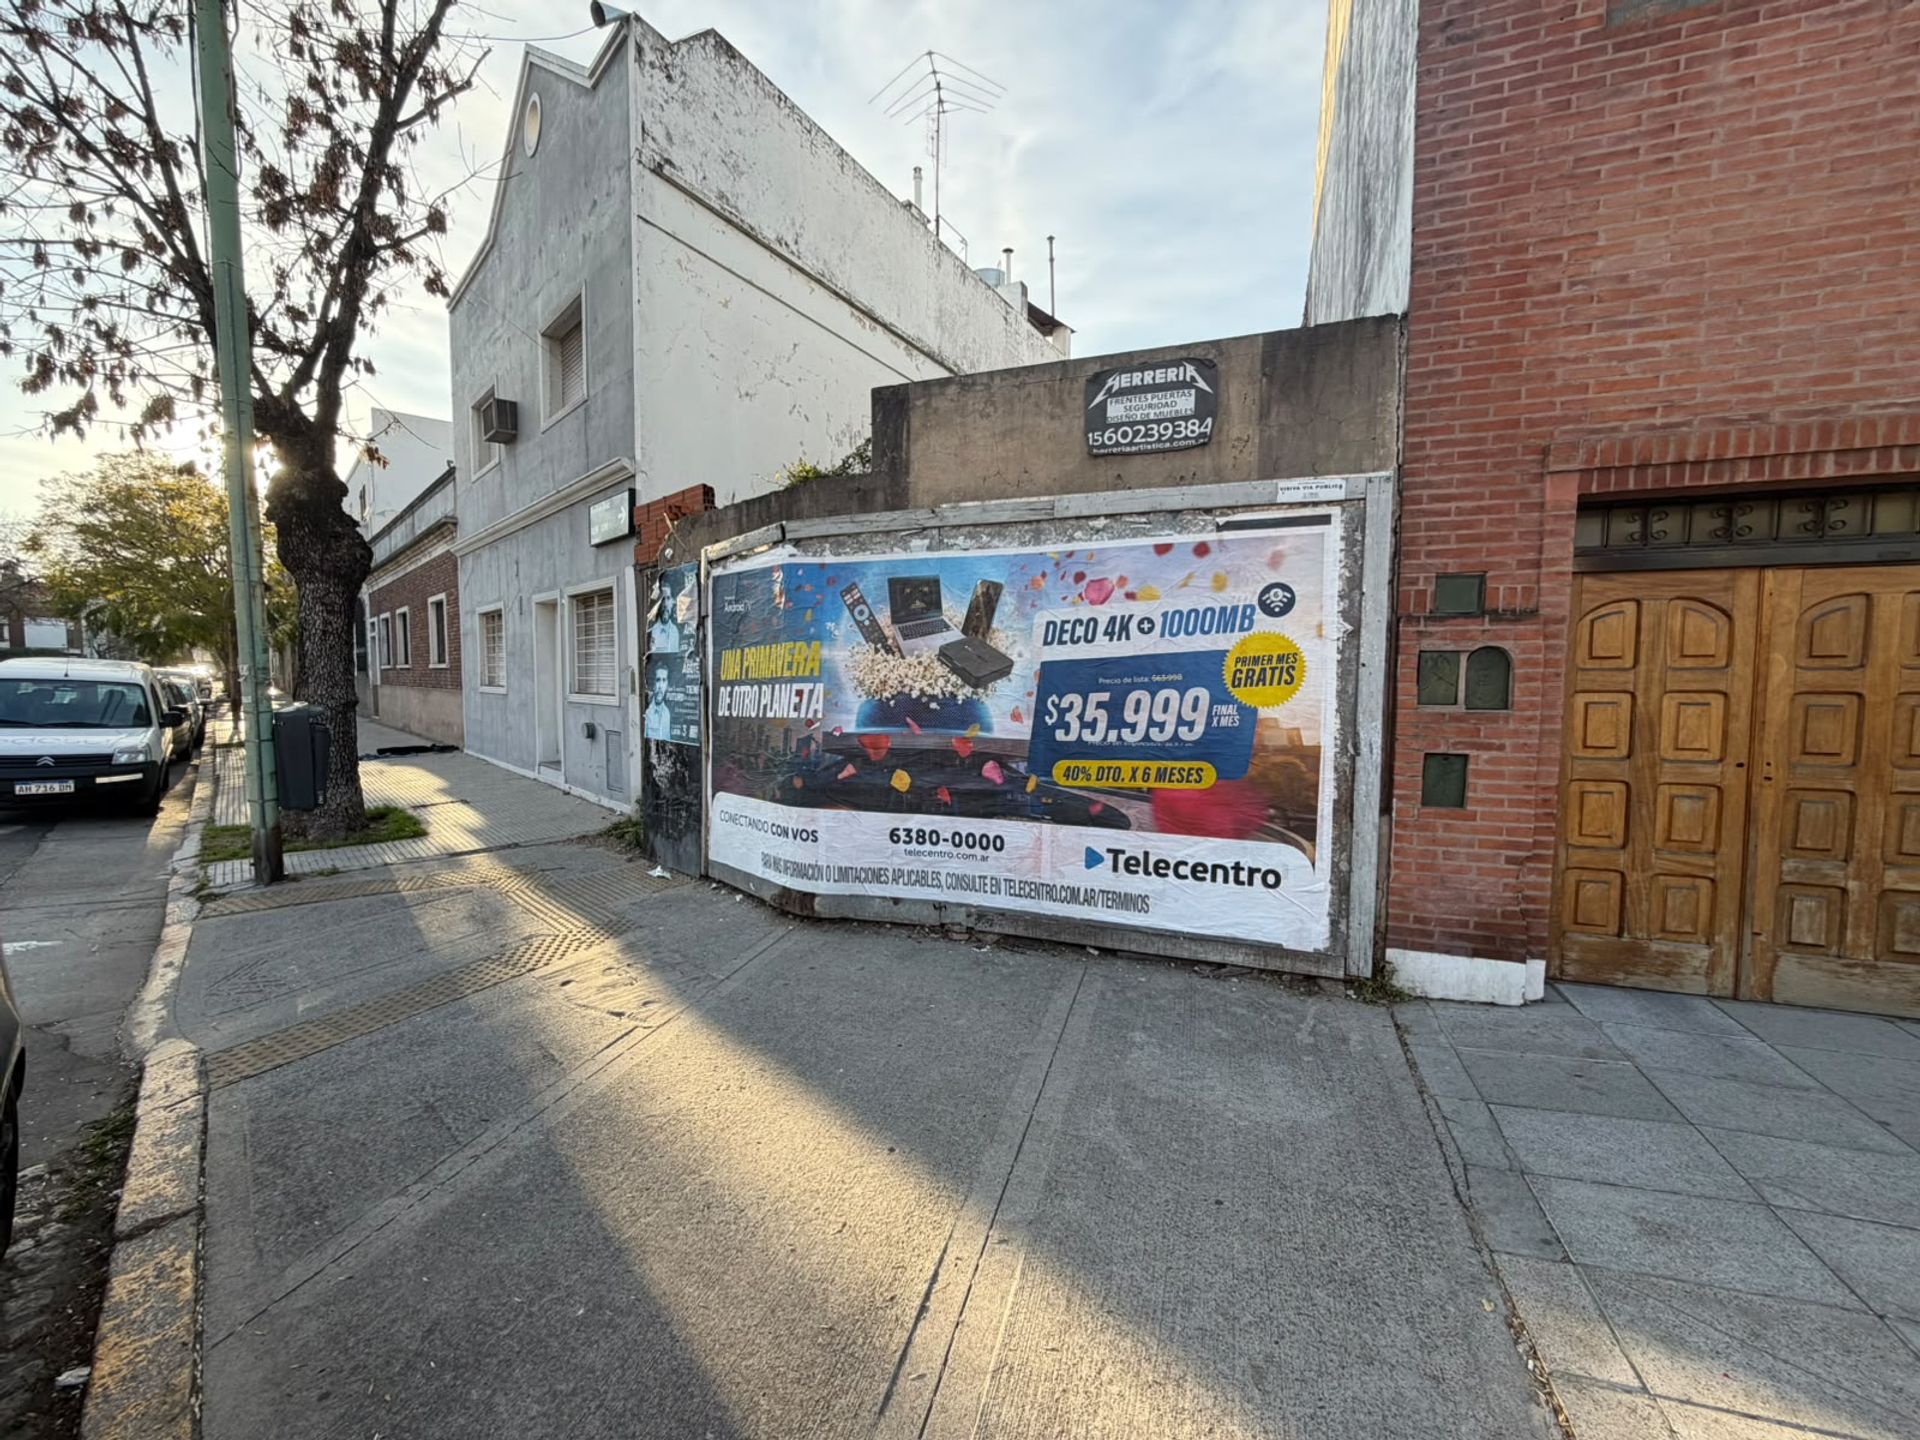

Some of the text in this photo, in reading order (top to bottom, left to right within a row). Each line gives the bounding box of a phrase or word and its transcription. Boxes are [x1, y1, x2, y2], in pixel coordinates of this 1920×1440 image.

[1088, 361, 1214, 409] HERRERIA
[1109, 390, 1193, 407] FRENTES PUERTAS
[1123, 400, 1178, 413] SEGURIDAD
[1107, 407, 1194, 423] DISEÑO DE MUEBLES
[1088, 416, 1213, 446] 1560239384
[1043, 616, 1099, 647] DECO
[1103, 614, 1134, 643] 4K
[1159, 603, 1257, 639] 1000MB
[720, 640, 822, 681] UNA PRIMAVERA
[1234, 652, 1299, 668] PRIMER MES
[1098, 677, 1122, 685] Precio
[1122, 676, 1133, 684] de
[1231, 665, 1296, 689] GRATIS
[718, 682, 824, 719] DE OTRO PLANETA
[1212, 704, 1239, 716] FINAL
[1045, 686, 1211, 743] $35.999
[1212, 716, 1240, 728] X MES
[1063, 765, 1205, 784] 40% DTO. X 6 MESES
[720, 809, 819, 843] CONECTANDO CON VOS
[889, 827, 1005, 852] 6380-0000
[904, 848, 990, 862] telecentro.com.ar
[1105, 847, 1282, 890] Telecentro
[783, 858, 825, 882] INFORMACIÓN
[825, 864, 832, 883] O
[832, 864, 890, 885] LIMITACIONES
[891, 867, 944, 892] APLICABLES,
[945, 871, 988, 894] CONSULTE
[990, 876, 1002, 896] EN
[1003, 878, 1150, 914] TELECENTRO.COM.AR/TERMINOS
